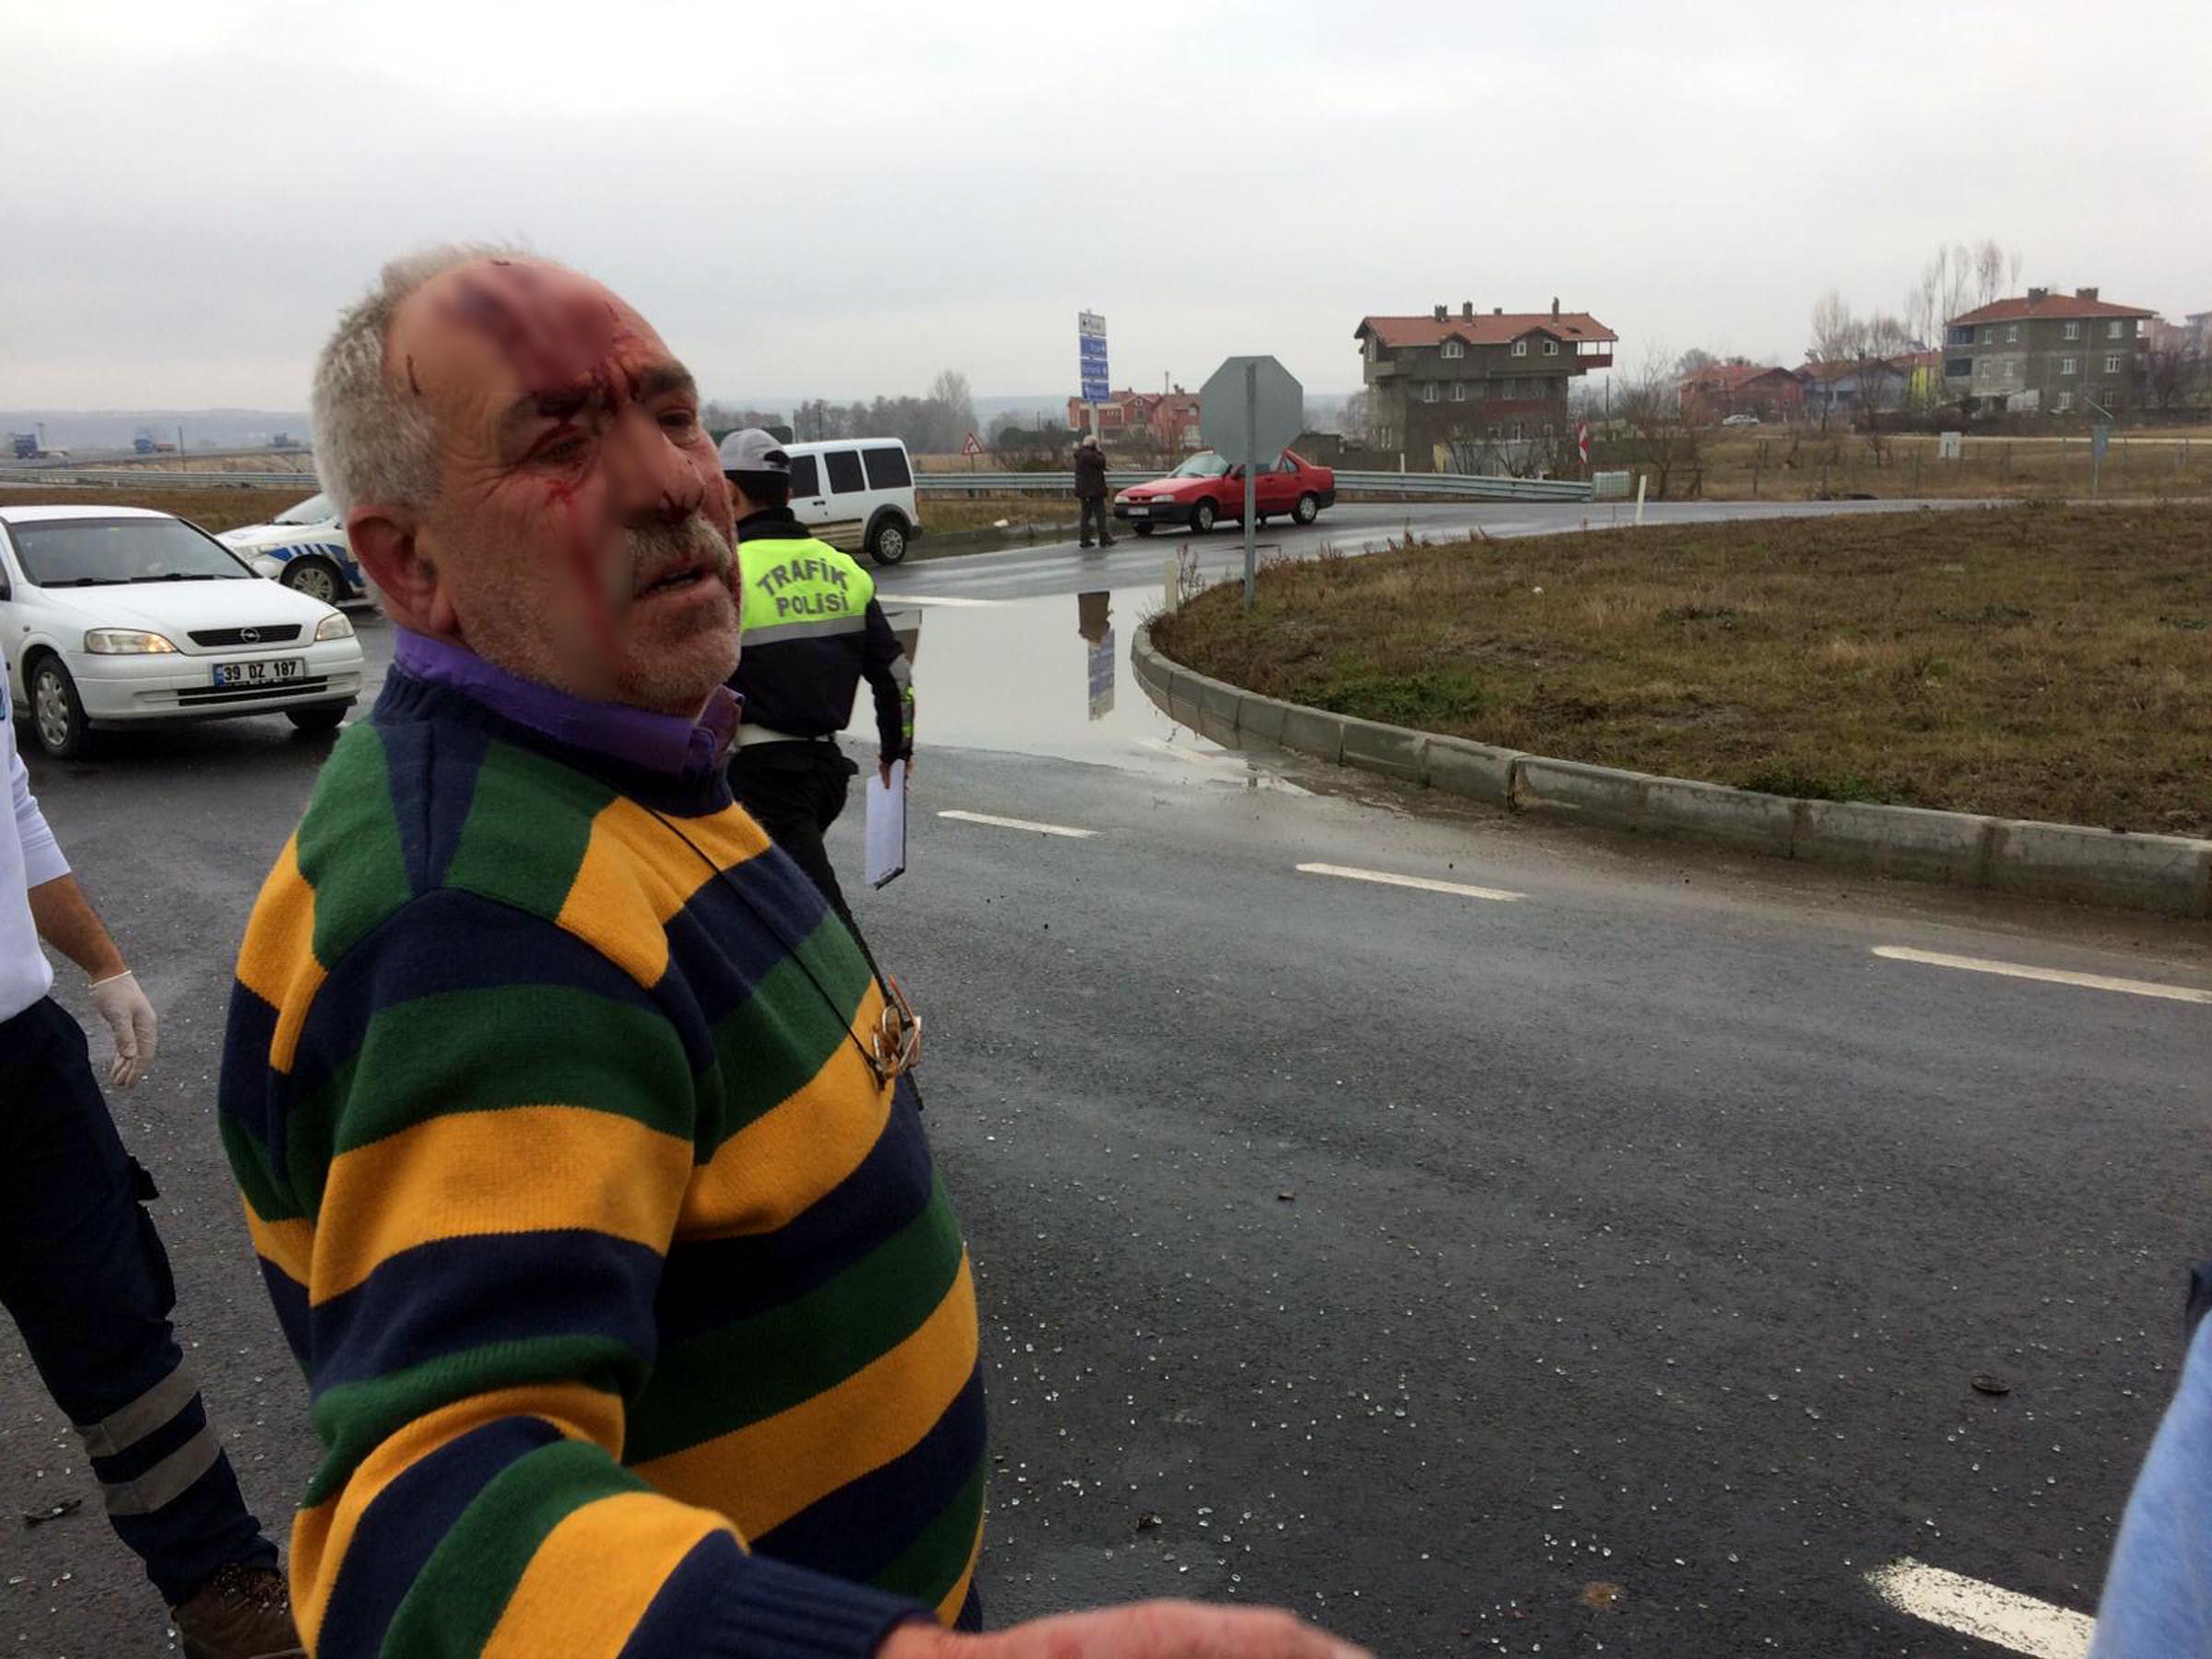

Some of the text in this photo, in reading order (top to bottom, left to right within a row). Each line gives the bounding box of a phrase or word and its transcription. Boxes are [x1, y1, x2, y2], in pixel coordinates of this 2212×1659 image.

[756, 558, 849, 597] TRAFİK
[775, 592, 850, 618] POLİSİ
[223, 661, 297, 681] 39 DZ 187
